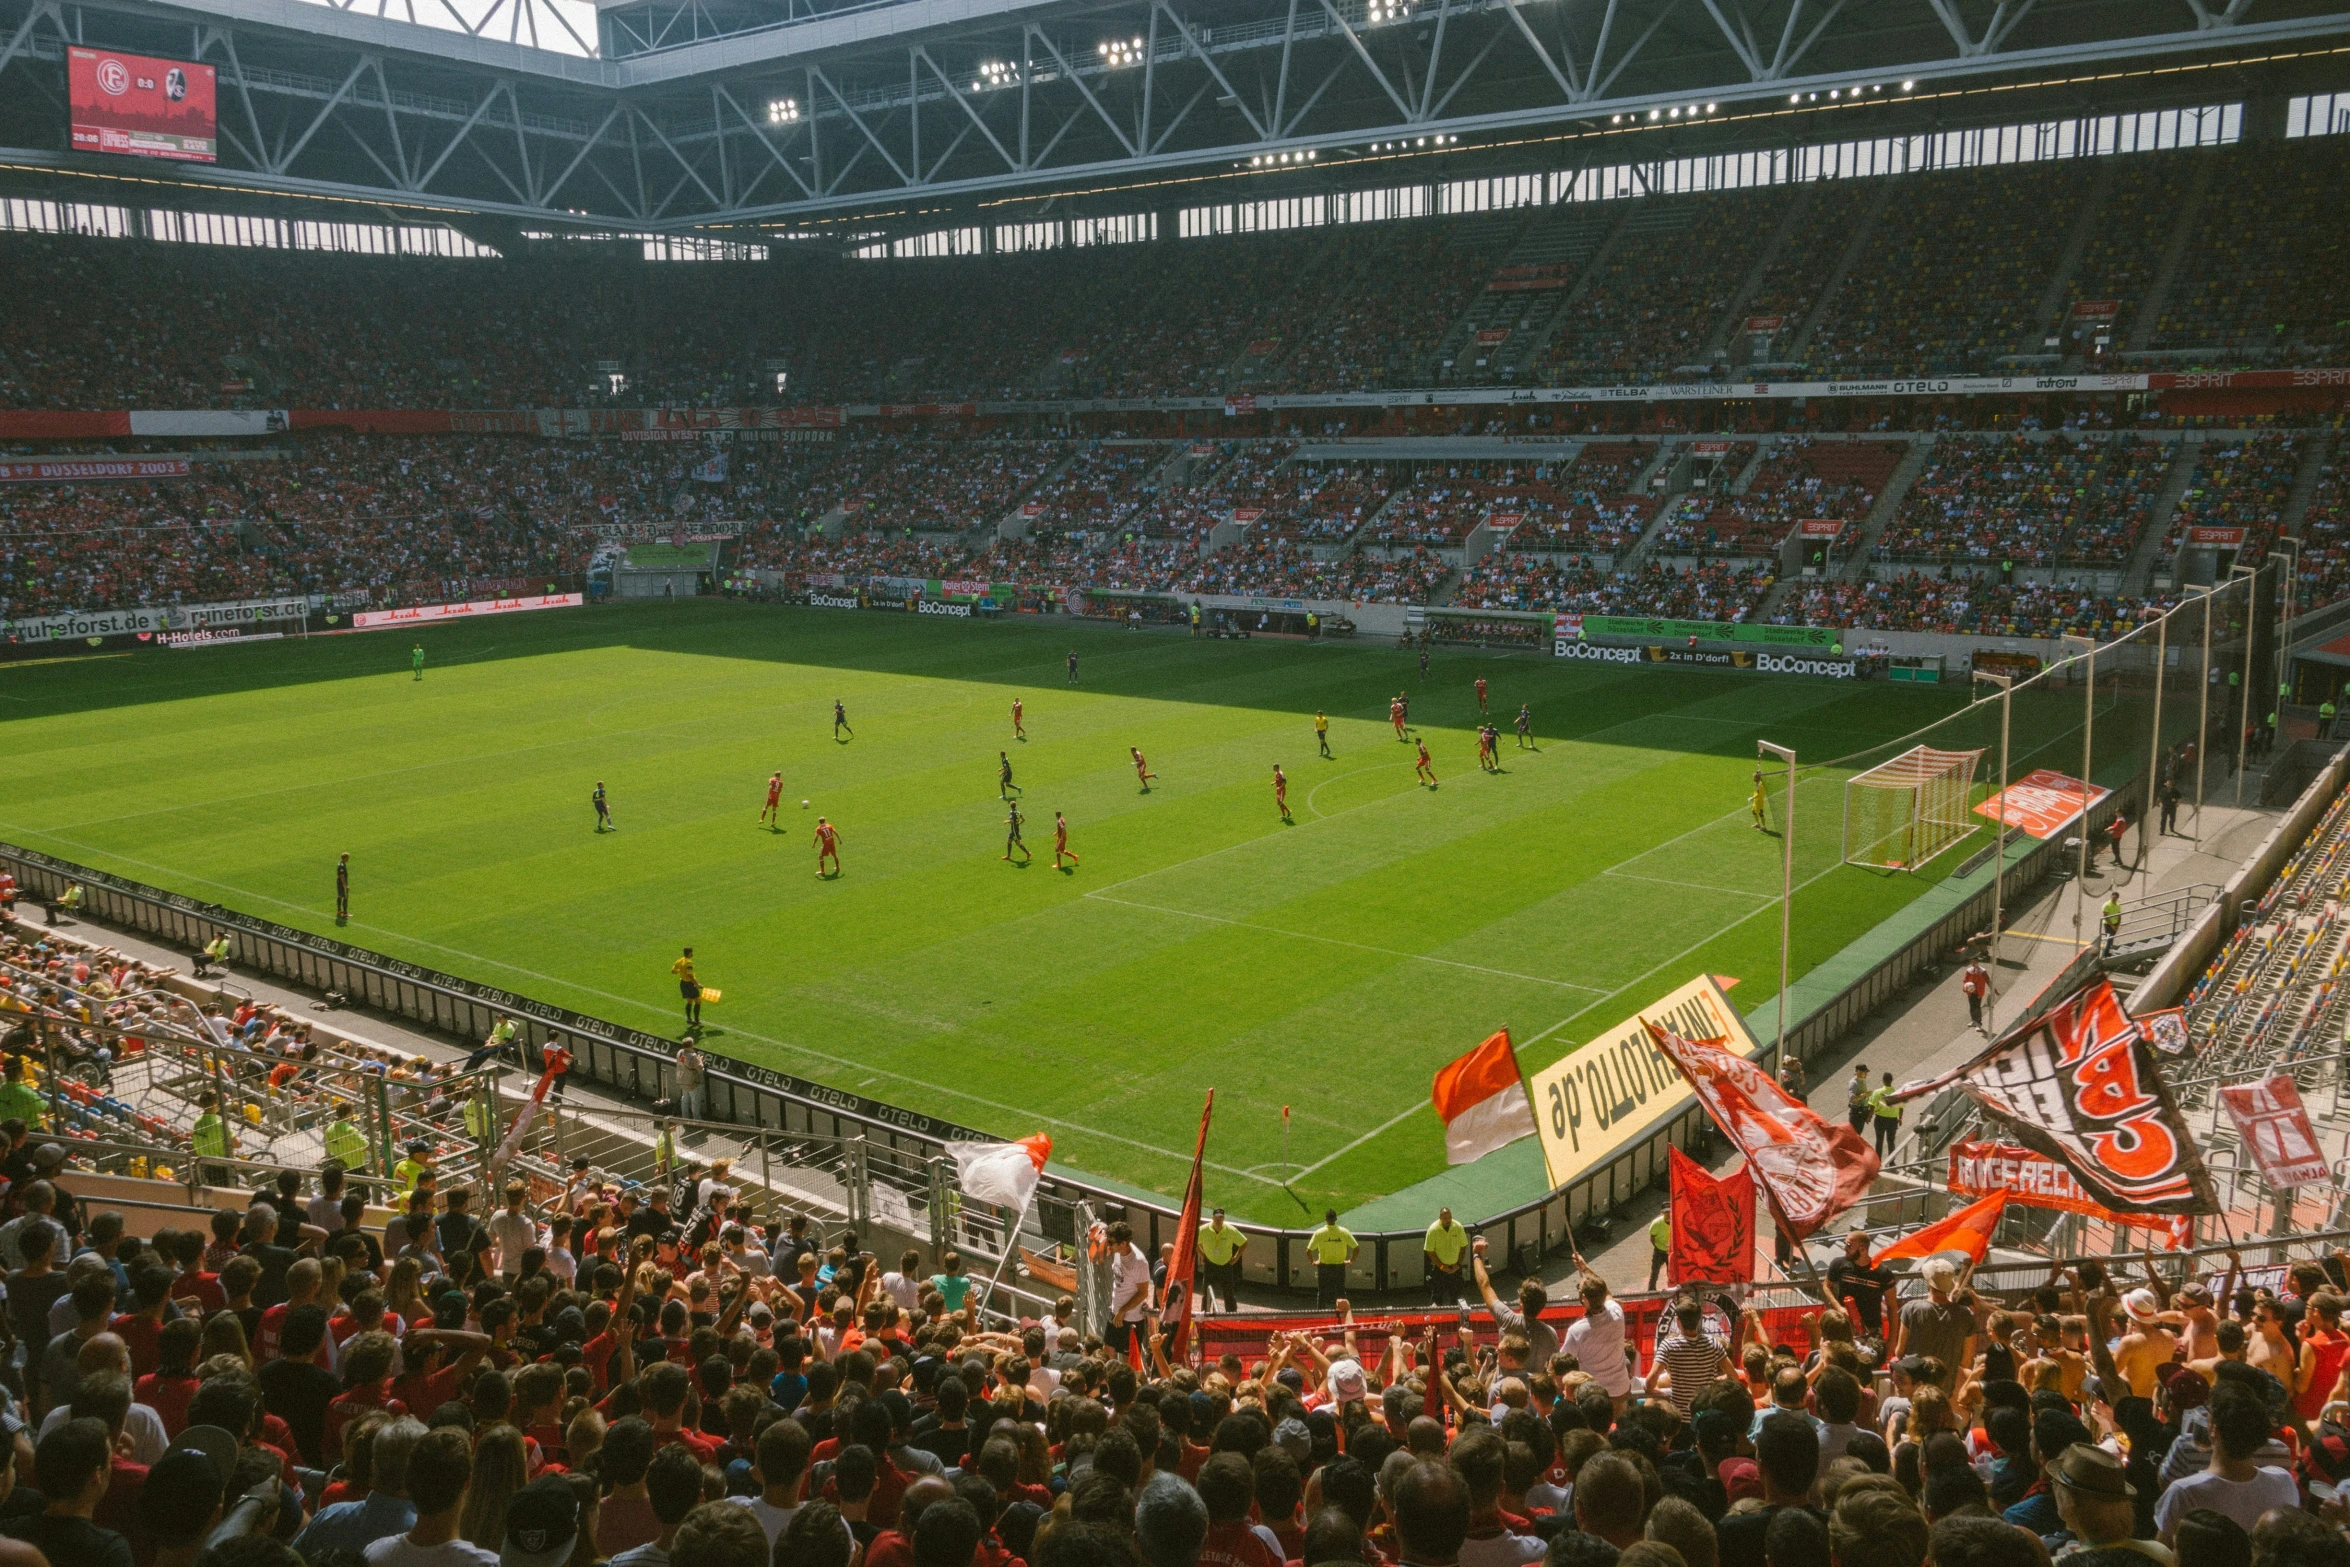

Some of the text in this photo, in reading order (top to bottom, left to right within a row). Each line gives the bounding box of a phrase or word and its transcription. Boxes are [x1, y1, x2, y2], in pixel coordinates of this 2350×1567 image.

[137, 78, 155, 89] 0:0
[1501, 373, 1513, 381] sky
[2101, 376, 2137, 386] ESPRIT
[2175, 373, 2234, 388] ESPRIT
[1608, 389, 1648, 397] TELBA
[1670, 385, 1733, 396] WARSTEINER
[1700, 443, 1726, 451] ESPRIT
[40, 460, 176, 478] DÜSSELDORF 2003
[1495, 516, 1519, 525] ESPRIT
[1808, 522, 1837, 532] ESPRIT
[2199, 531, 2236, 541] ESPRIT
[943, 580, 962, 591] Roter
[811, 593, 858, 610] BoConcept
[919, 601, 971, 618] BoConcept
[1607, 619, 1646, 627] Stadtwerke
[1674, 623, 1713, 631] Stadtwerke
[1607, 626, 1645, 635] Düsseldorf
[1764, 627, 1806, 636] Stadtwerke
[1764, 635, 1805, 644] Düsseldorf
[1554, 641, 1642, 664] BoConcept
[1670, 652, 1730, 663] 2x in D'dorf!
[1756, 654, 1857, 679] BoConcept
